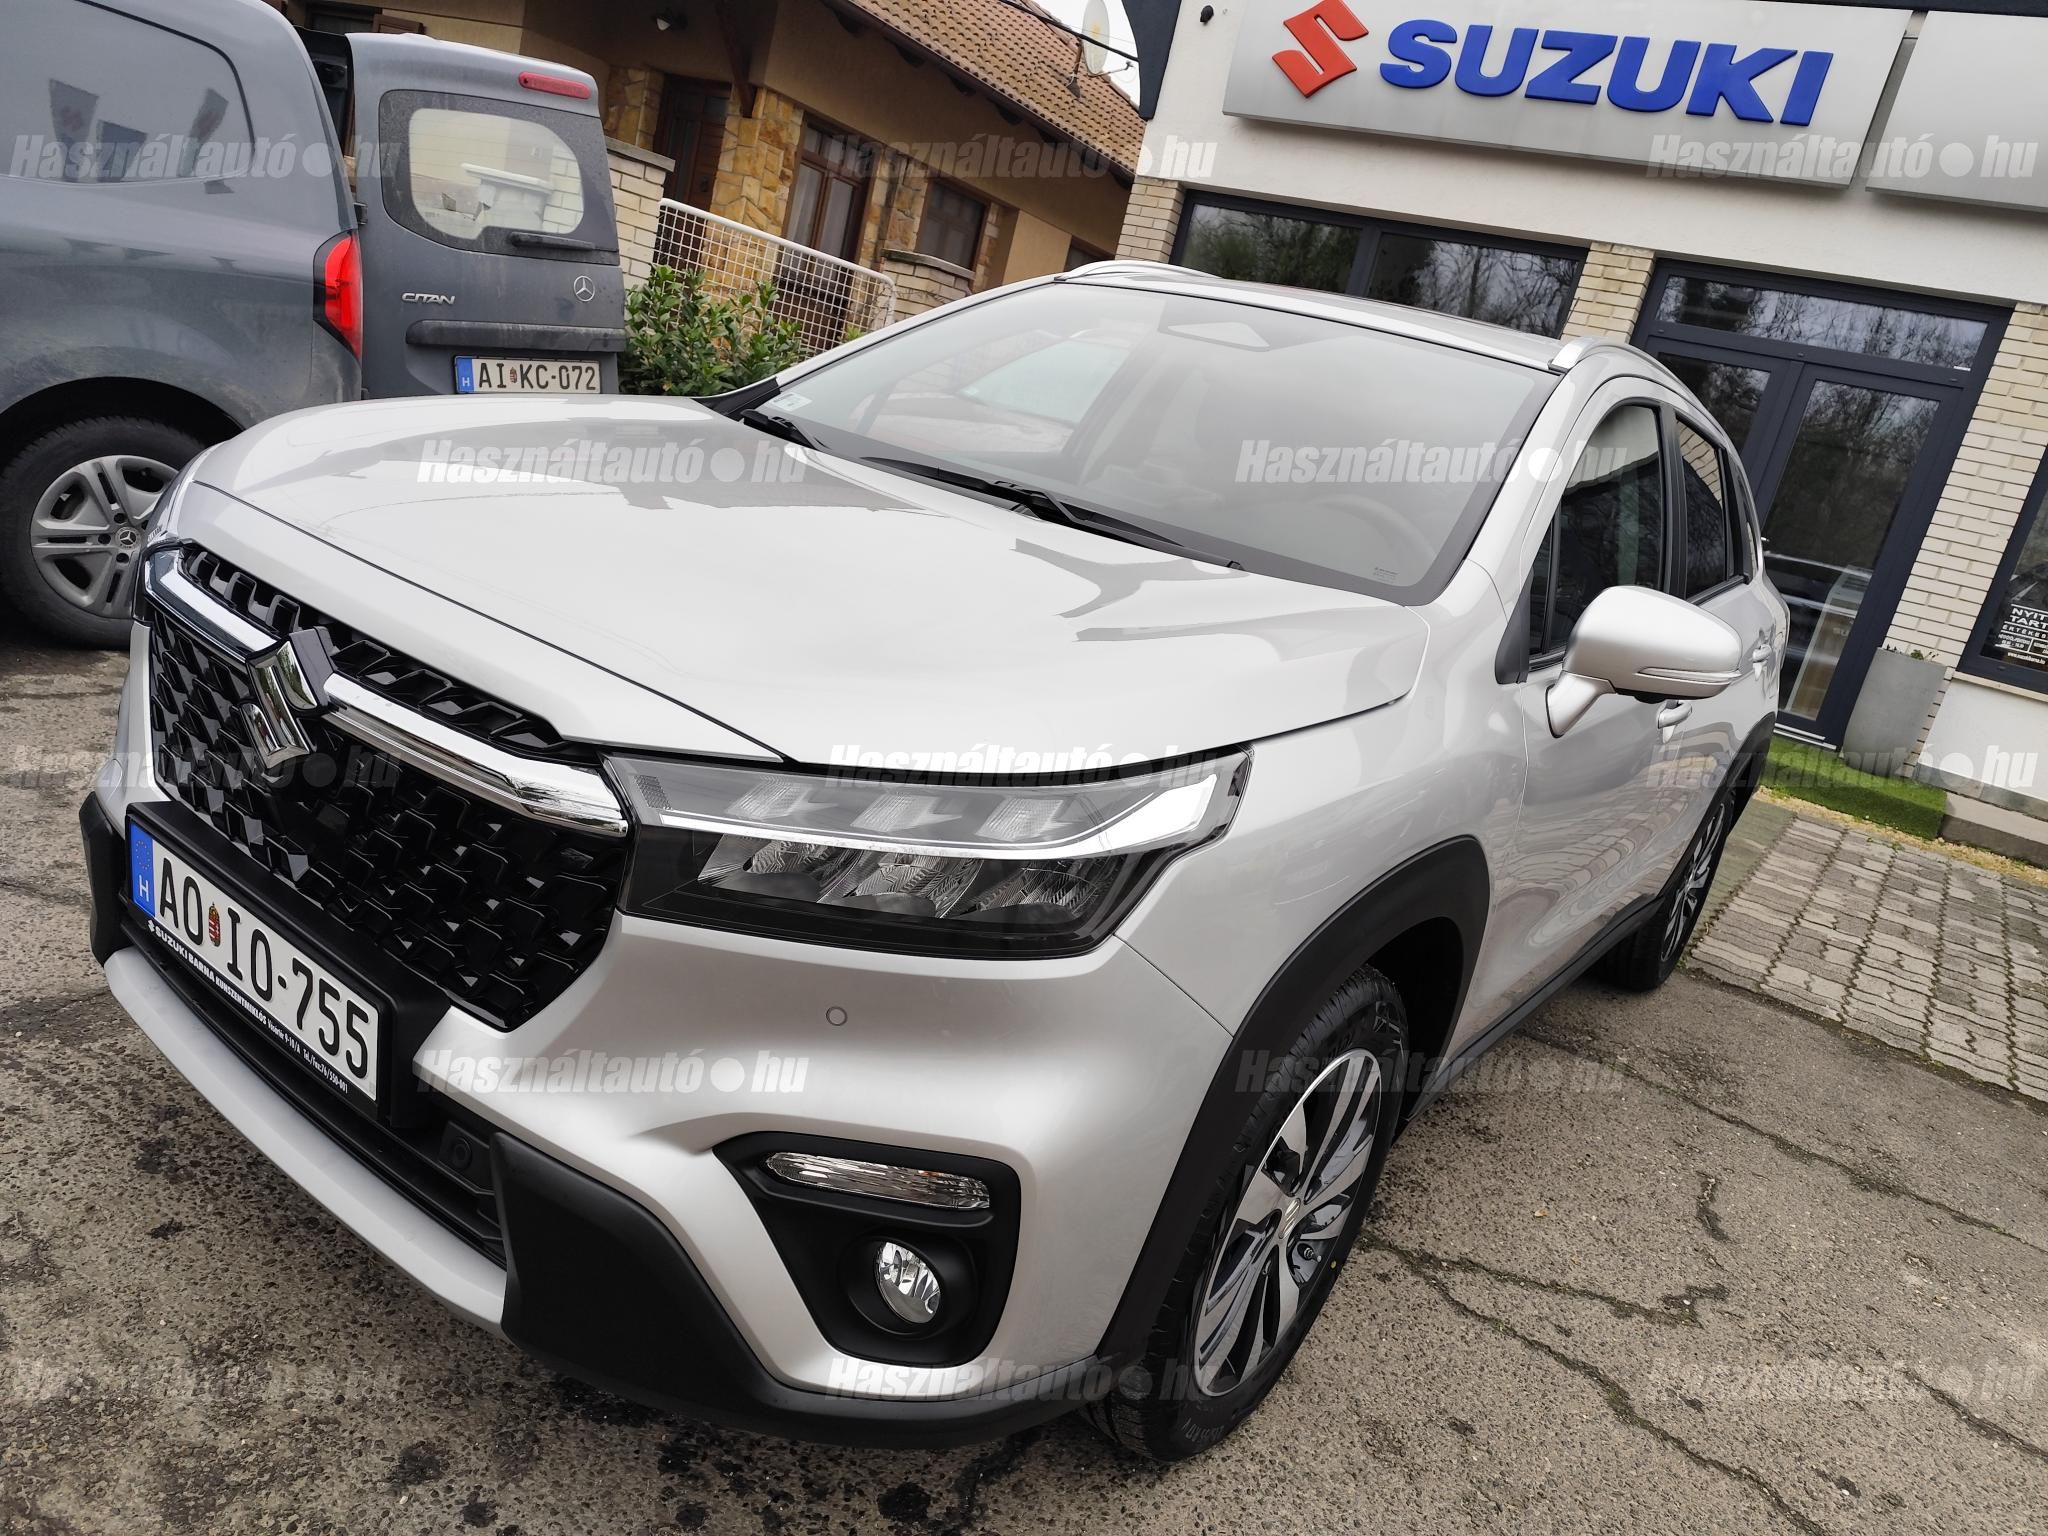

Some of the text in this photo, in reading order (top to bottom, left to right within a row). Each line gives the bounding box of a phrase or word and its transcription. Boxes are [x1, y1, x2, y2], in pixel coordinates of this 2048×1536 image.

[1380, 19, 1834, 126] SUZUKI
[401, 292, 456, 305] CITAN
[155, 925, 188, 961] SUZUKI
[188, 950, 215, 982] BARNA
